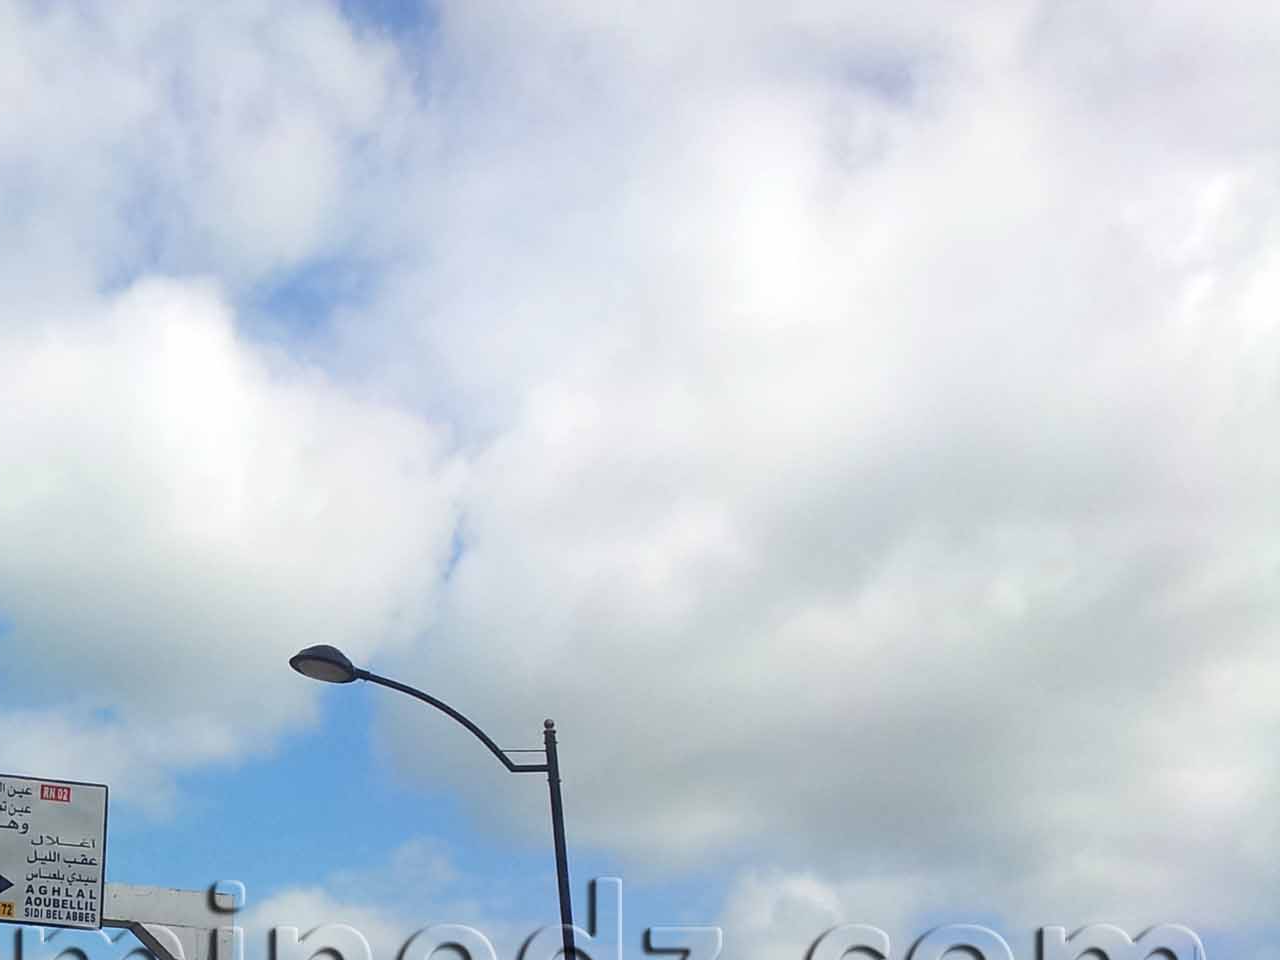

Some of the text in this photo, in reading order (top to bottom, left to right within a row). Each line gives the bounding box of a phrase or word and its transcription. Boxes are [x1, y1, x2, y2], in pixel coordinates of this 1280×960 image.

[7, 785, 33, 798] عين
[42, 785, 69, 800] RN 02
[8, 804, 32, 816] عين
[26, 849, 98, 868] عقب الليل
[25, 867, 97, 886] سيدي بلعباس
[25, 884, 96, 900] AGHLAL
[1, 904, 13, 916] 72
[24, 895, 96, 912] AOUBELLIL
[24, 907, 96, 923] SIDI BEL ABBES
